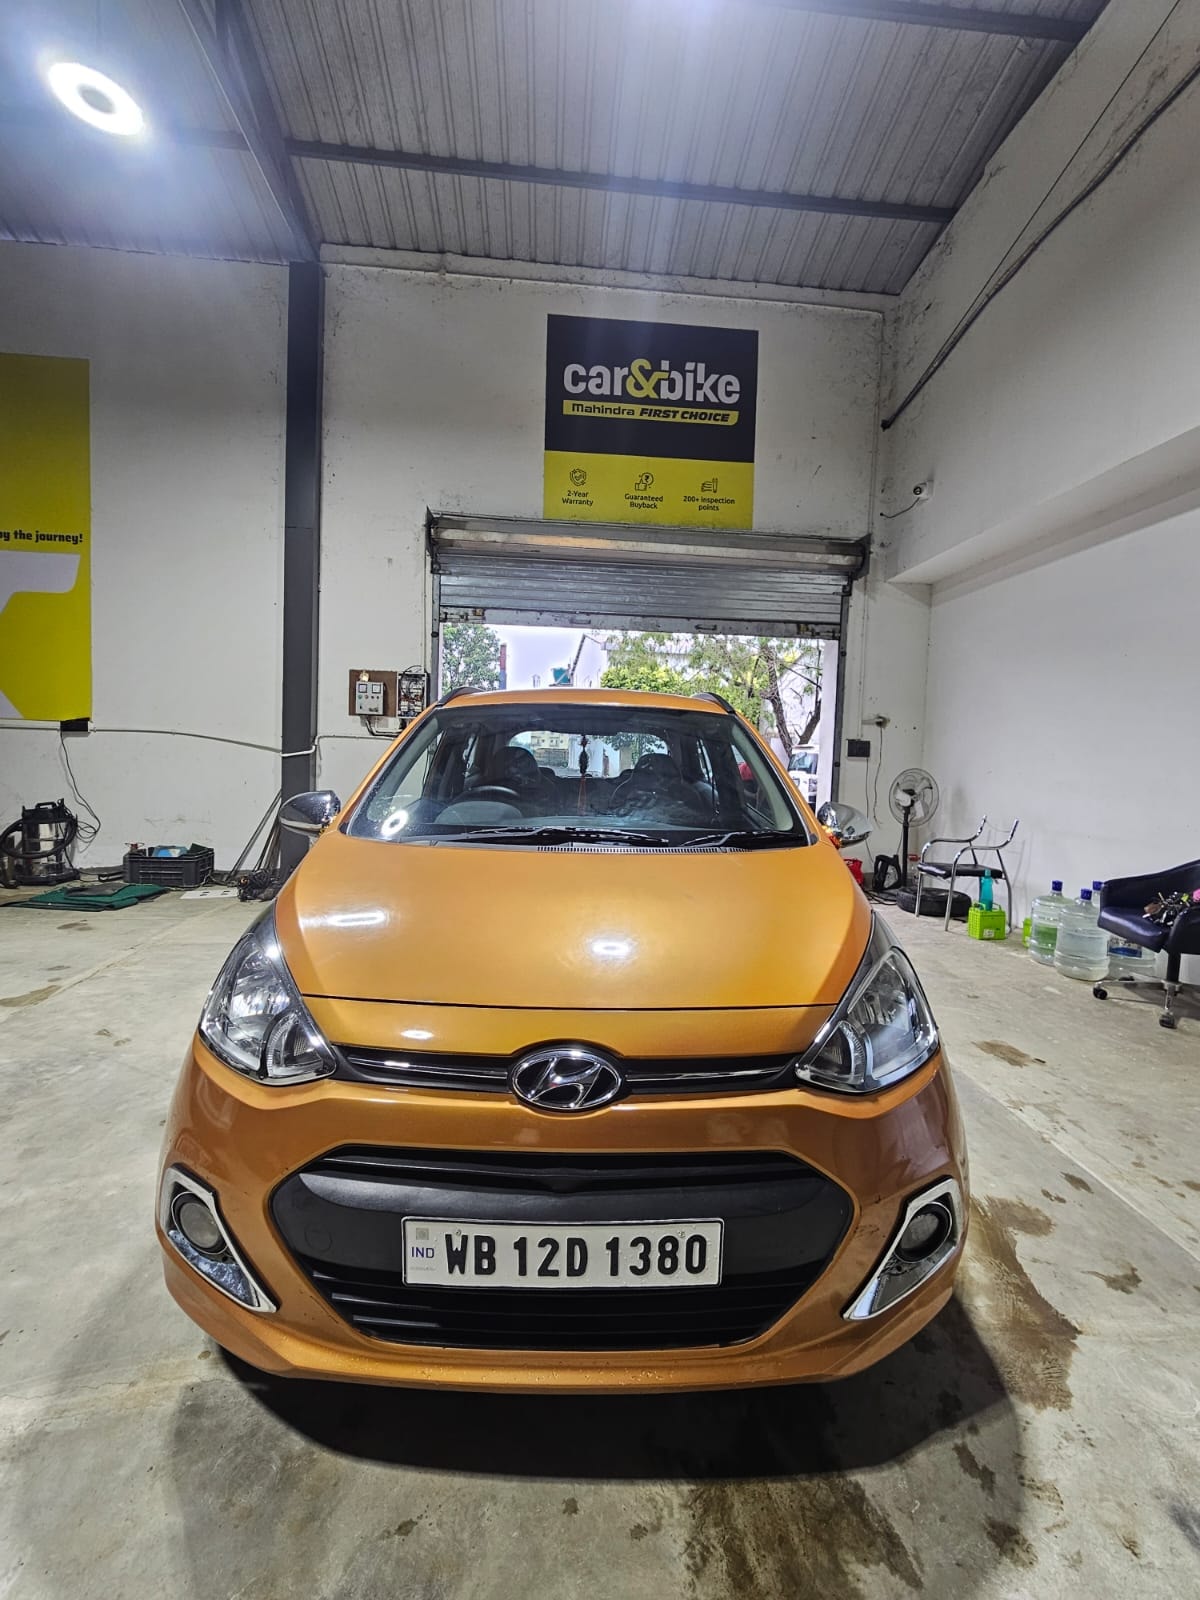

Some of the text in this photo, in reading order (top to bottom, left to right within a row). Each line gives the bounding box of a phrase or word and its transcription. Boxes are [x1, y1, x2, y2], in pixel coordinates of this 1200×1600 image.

[563, 358, 741, 405] car&bike
[572, 403, 730, 422] Mahindra FIRST CHOICE
[567, 490, 589, 498] 2-Year
[624, 493, 664, 502] Guaranteed
[561, 497, 594, 506] Warranty
[629, 501, 658, 510] Buyback
[14, 530, 32, 540] the
[35, 530, 83, 545] journey!
[411, 1246, 435, 1258] IND
[445, 1233, 708, 1277] WB 12D 1380
